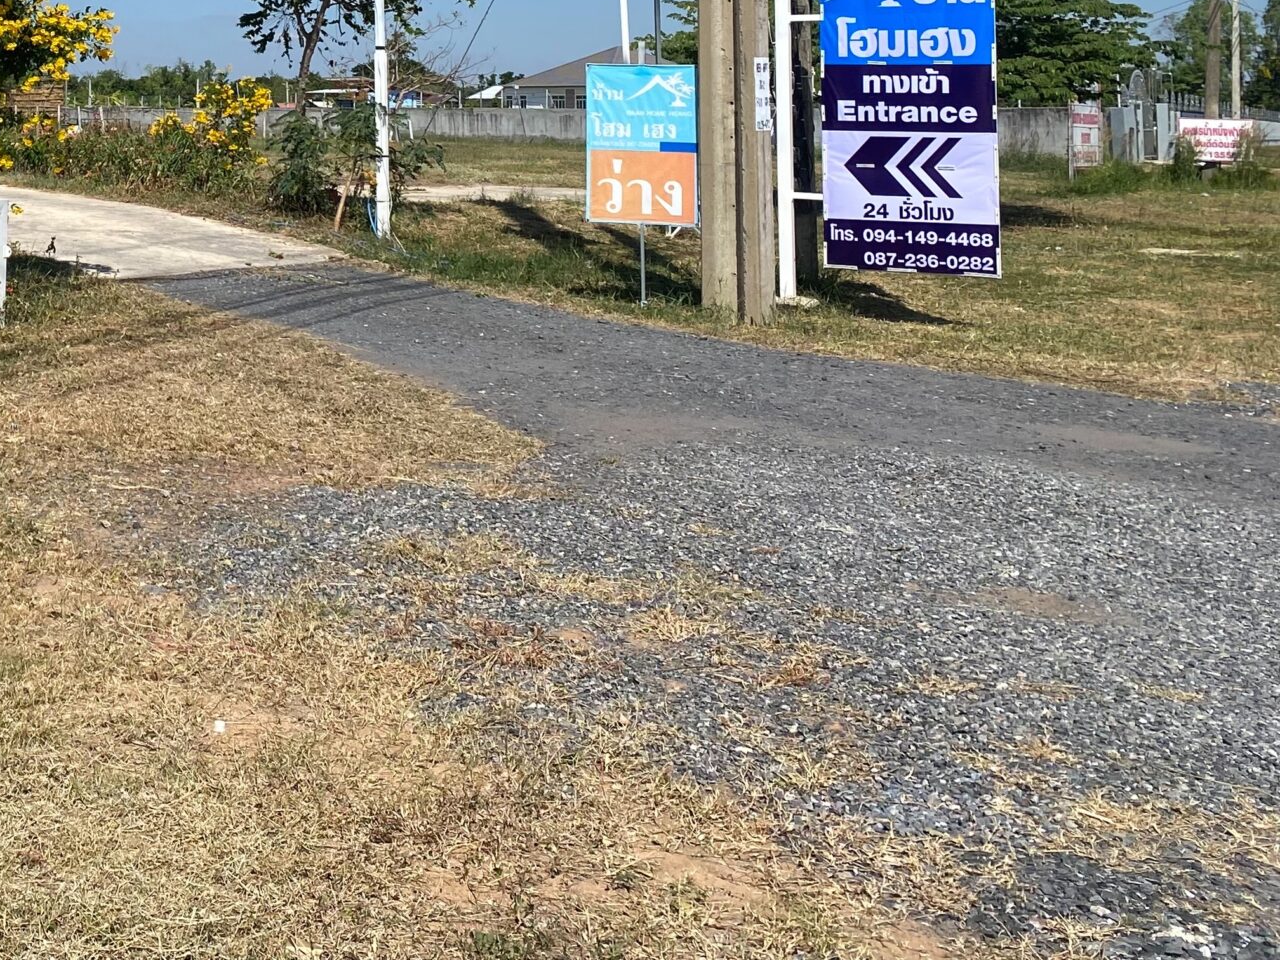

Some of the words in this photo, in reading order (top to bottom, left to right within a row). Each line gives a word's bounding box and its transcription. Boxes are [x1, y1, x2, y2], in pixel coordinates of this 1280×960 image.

[836, 16, 977, 58] โฮมเฮง
[591, 83, 624, 101] บ้าน
[862, 68, 950, 94] ทางเข้า
[837, 99, 978, 124] Entrance
[597, 158, 683, 217] ว่าง
[863, 203, 889, 219] 24
[899, 197, 955, 221] ชั่วโมง
[830, 223, 858, 242] โทร.
[863, 228, 994, 248] 094-149-4468
[863, 251, 994, 271] 087-236-0282
